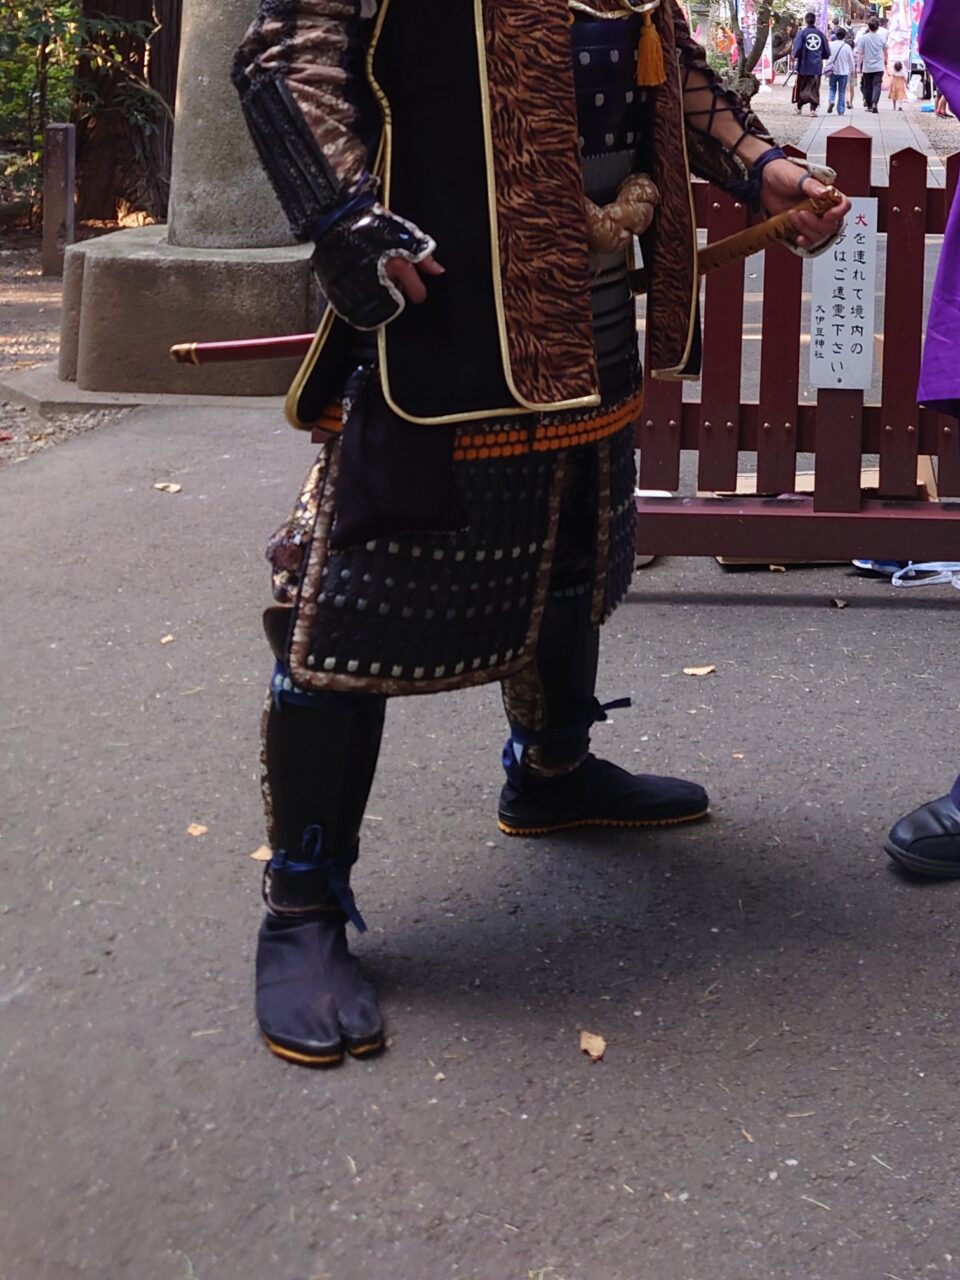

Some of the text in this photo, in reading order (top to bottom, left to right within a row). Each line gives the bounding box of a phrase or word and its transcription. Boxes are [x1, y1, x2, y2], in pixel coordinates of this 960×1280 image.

[814, 304, 826, 359] 久伊豆神社
[830, 223, 848, 383] はご遠慮下さい。
[850, 213, 868, 355] 犬を連れて境内の
